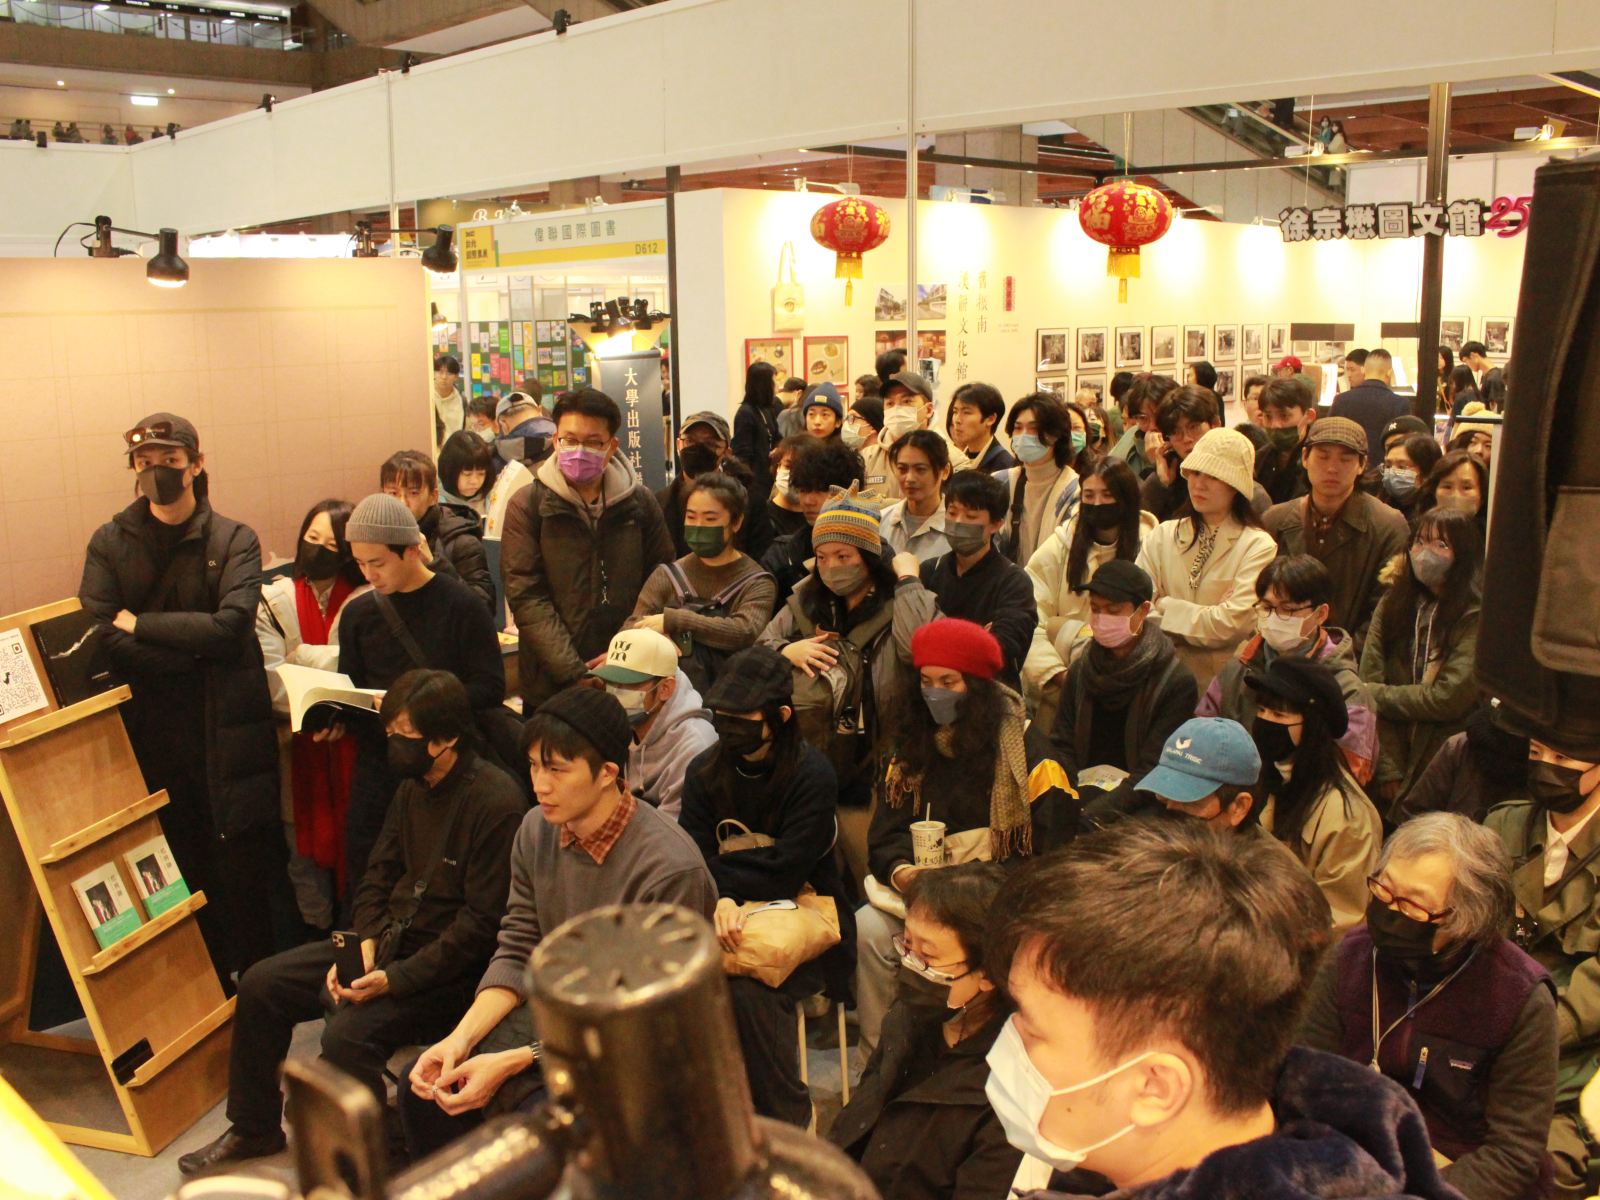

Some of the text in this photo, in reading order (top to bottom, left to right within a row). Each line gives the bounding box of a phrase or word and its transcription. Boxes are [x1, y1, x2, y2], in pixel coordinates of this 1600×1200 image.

[534, 219, 616, 243] 偉聯國際圖書
[1279, 196, 1533, 242] 徐宗懋圖文館 25
[635, 243, 659, 255] D612
